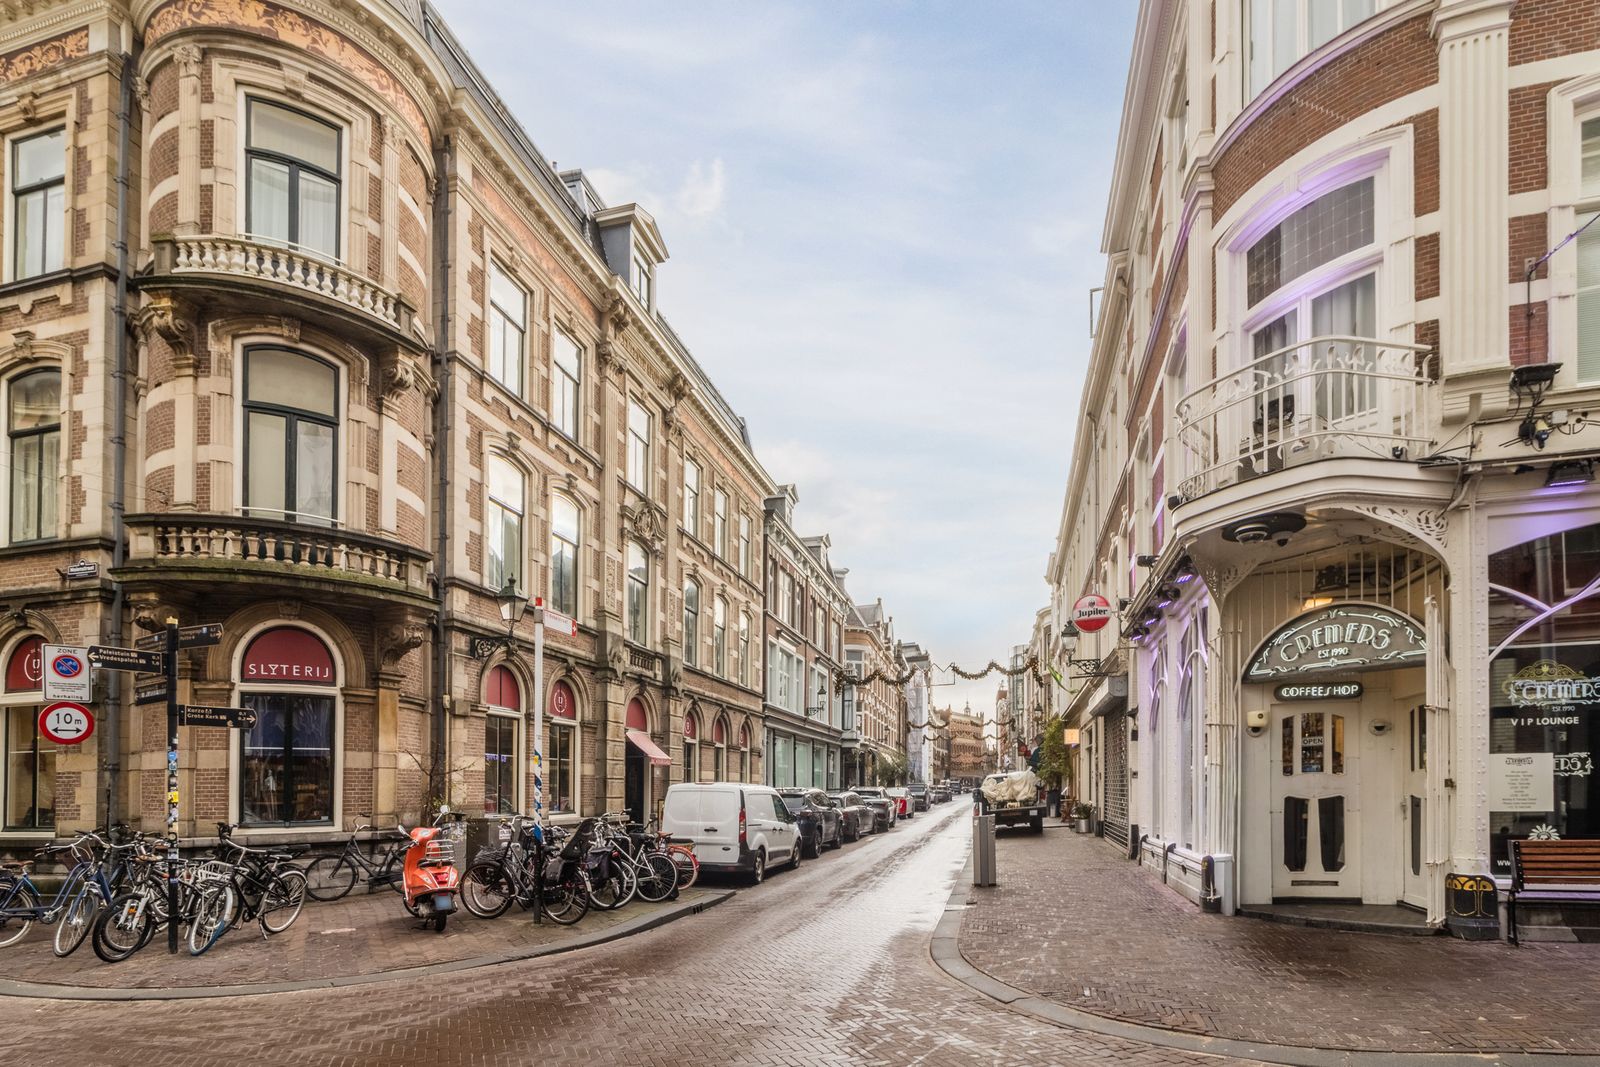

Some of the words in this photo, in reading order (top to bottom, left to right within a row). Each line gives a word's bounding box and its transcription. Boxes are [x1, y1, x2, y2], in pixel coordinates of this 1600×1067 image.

[1078, 608, 1108, 619] Jupiler
[1280, 623, 1391, 662] CREMERS
[1317, 649, 1330, 659] EST
[1331, 646, 1349, 657] 1990
[248, 663, 329, 678] SLYTERIJ
[55, 713, 73, 725] 10
[1536, 716, 1580, 726] LOUNGE
